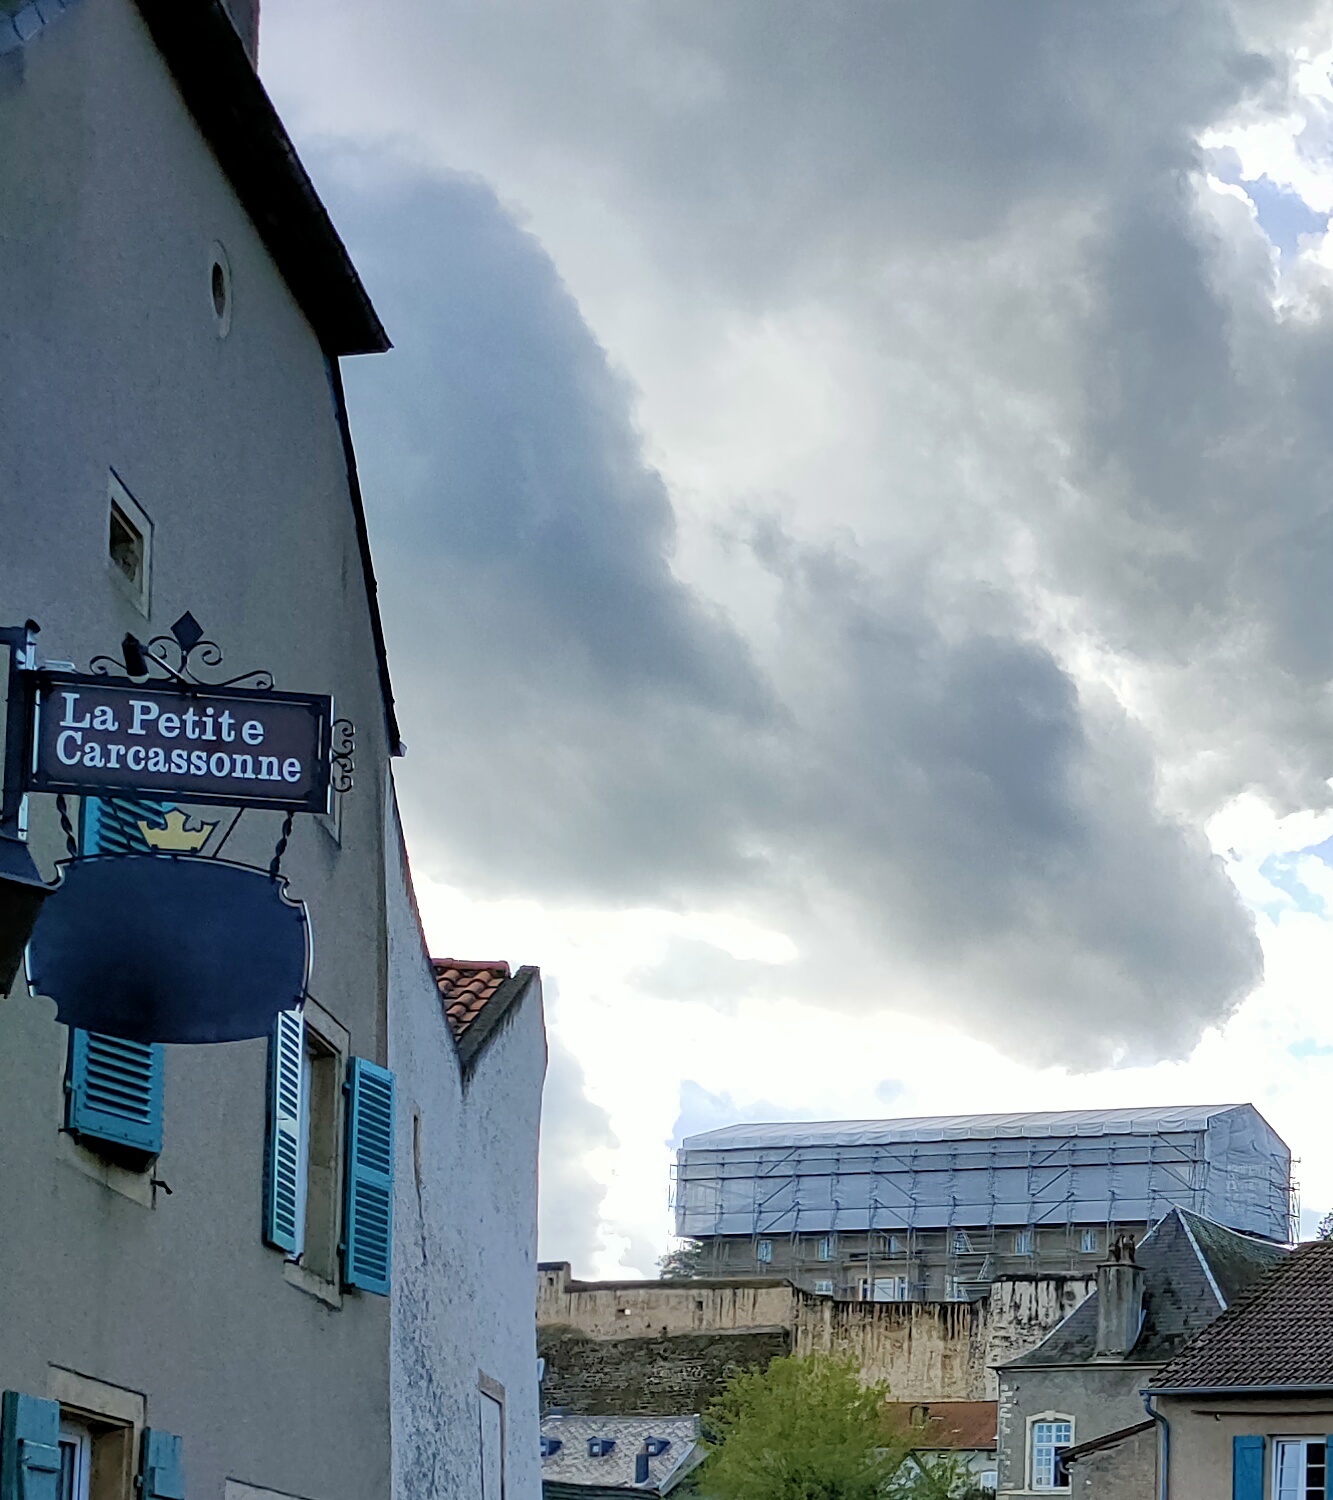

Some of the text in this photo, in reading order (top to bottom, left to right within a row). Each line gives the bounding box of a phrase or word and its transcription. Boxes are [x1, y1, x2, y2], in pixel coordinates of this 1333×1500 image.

[61, 693, 264, 745] La Petite
[56, 730, 301, 782] Carcassonne
